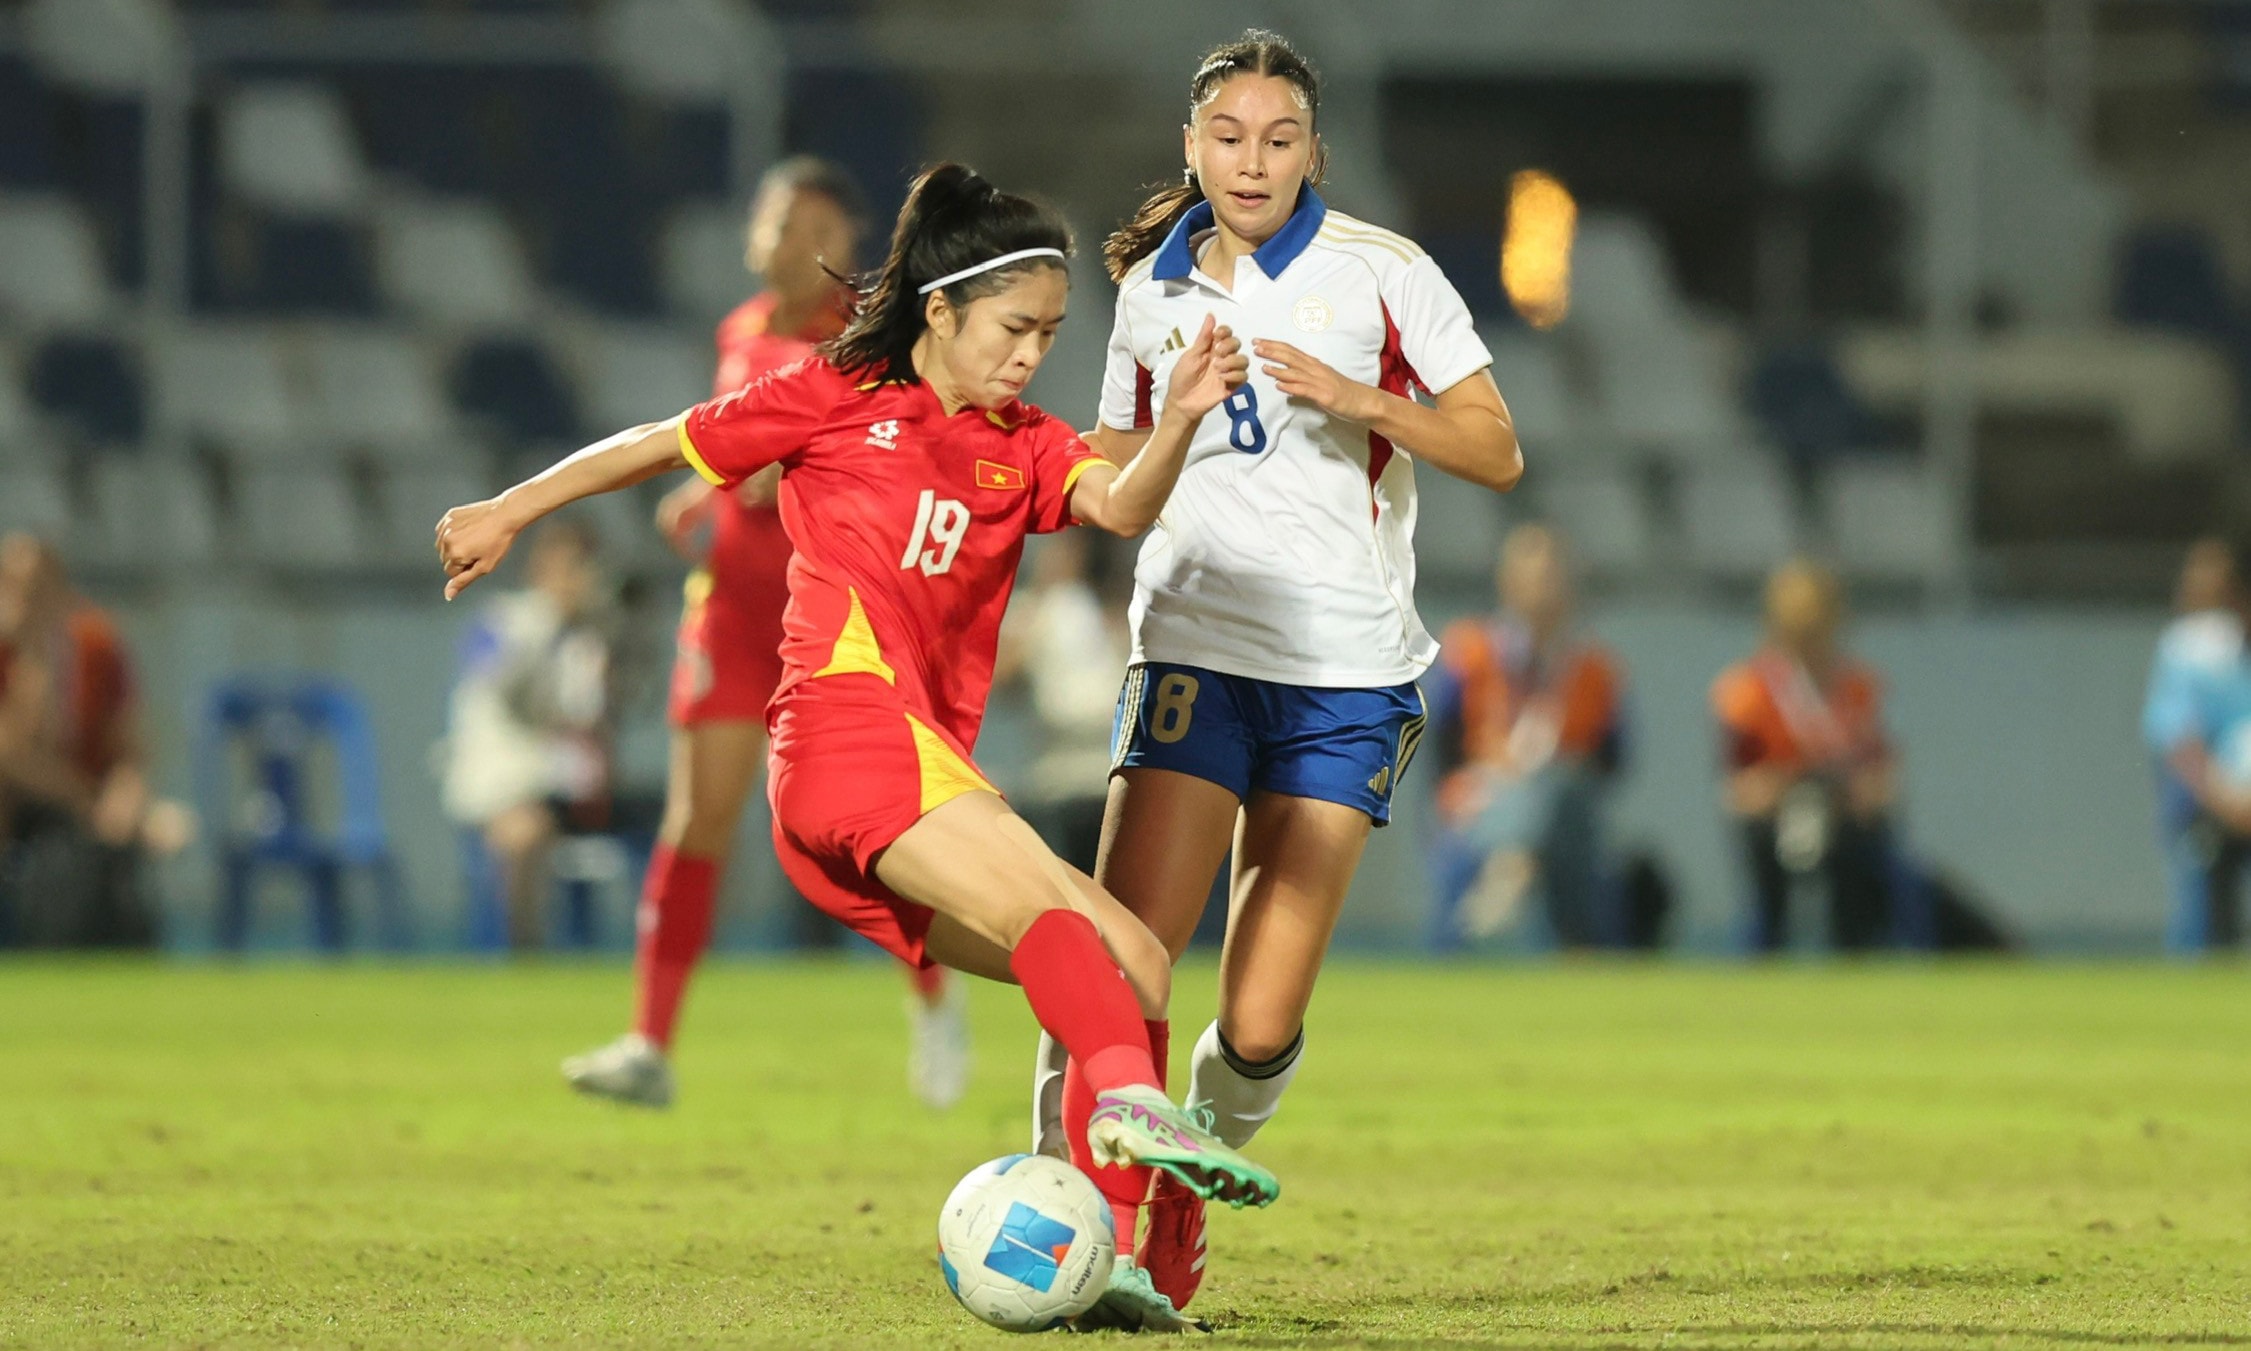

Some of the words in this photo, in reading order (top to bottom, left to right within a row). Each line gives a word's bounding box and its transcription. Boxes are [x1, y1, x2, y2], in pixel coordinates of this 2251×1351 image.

[1223, 382, 1267, 455] 8
[900, 489, 971, 578] 19
[1151, 673, 1199, 743] 8
[1071, 1246, 1098, 1295] molten
